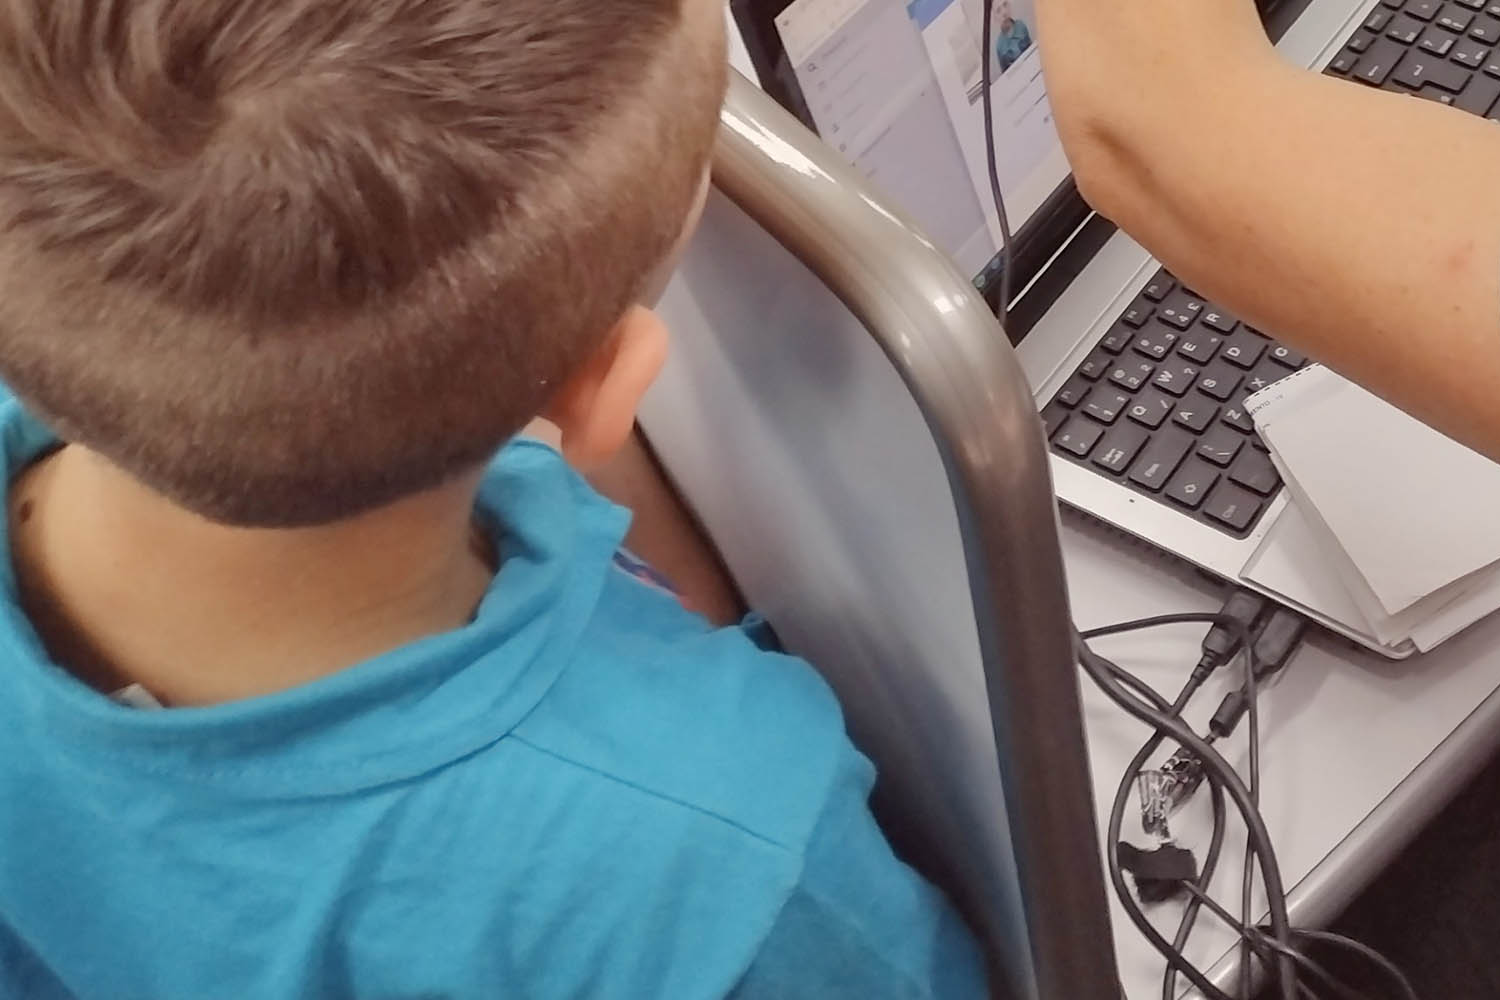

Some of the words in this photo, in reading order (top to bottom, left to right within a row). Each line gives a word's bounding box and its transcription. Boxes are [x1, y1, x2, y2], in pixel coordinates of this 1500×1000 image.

[1181, 342, 1197, 352] E
[1205, 313, 1220, 323] R
[1179, 411, 1193, 421] A
[1203, 378, 1217, 388] S
[1226, 346, 1241, 357] D
